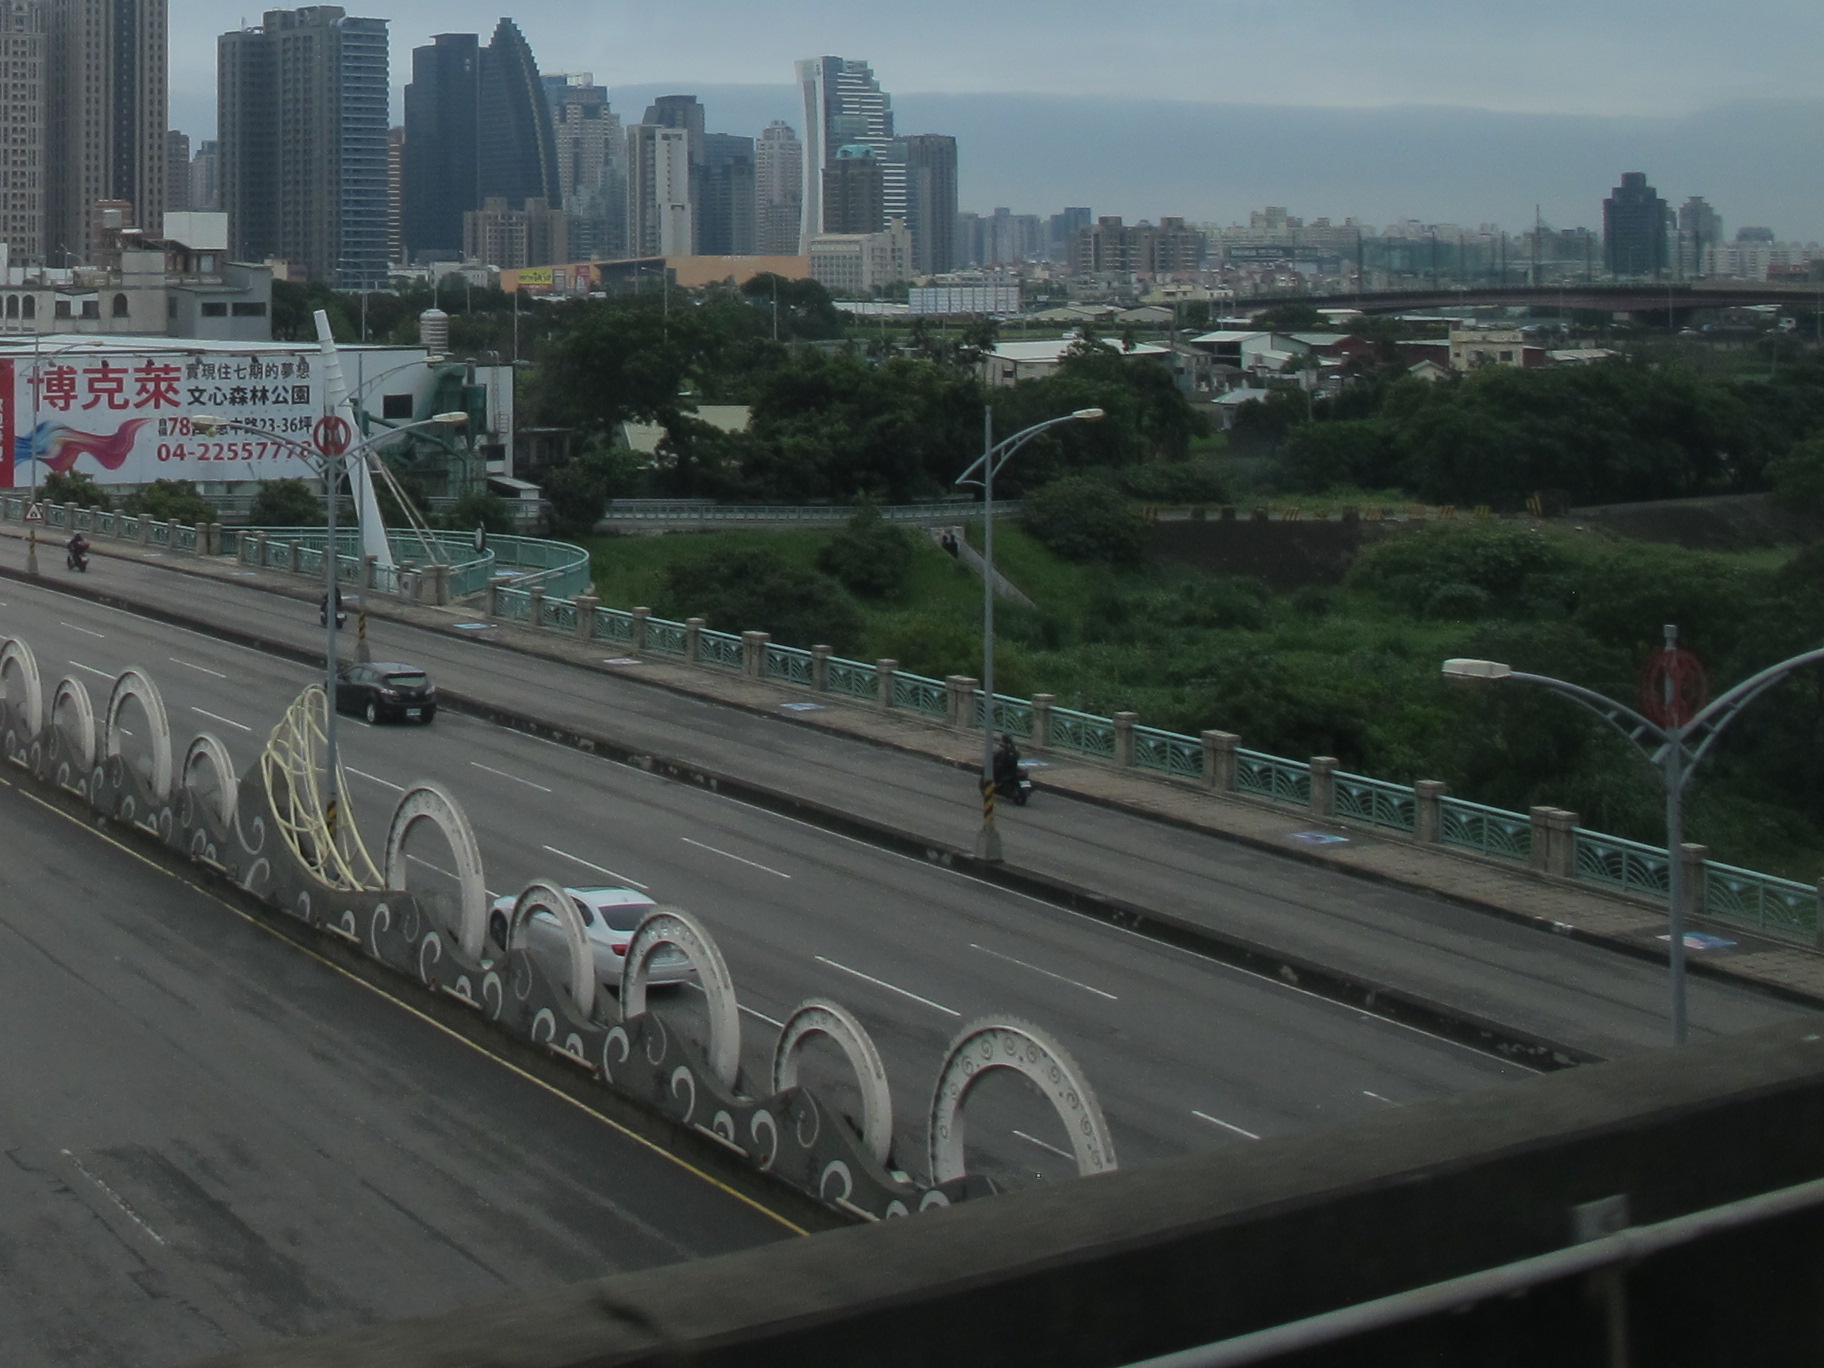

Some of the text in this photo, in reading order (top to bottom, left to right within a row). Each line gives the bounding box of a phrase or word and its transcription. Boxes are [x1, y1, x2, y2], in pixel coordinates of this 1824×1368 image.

[186, 362, 310, 381] 實現住七期的夢想
[27, 363, 182, 412] 博克萊
[187, 384, 310, 406] 文心森林公園
